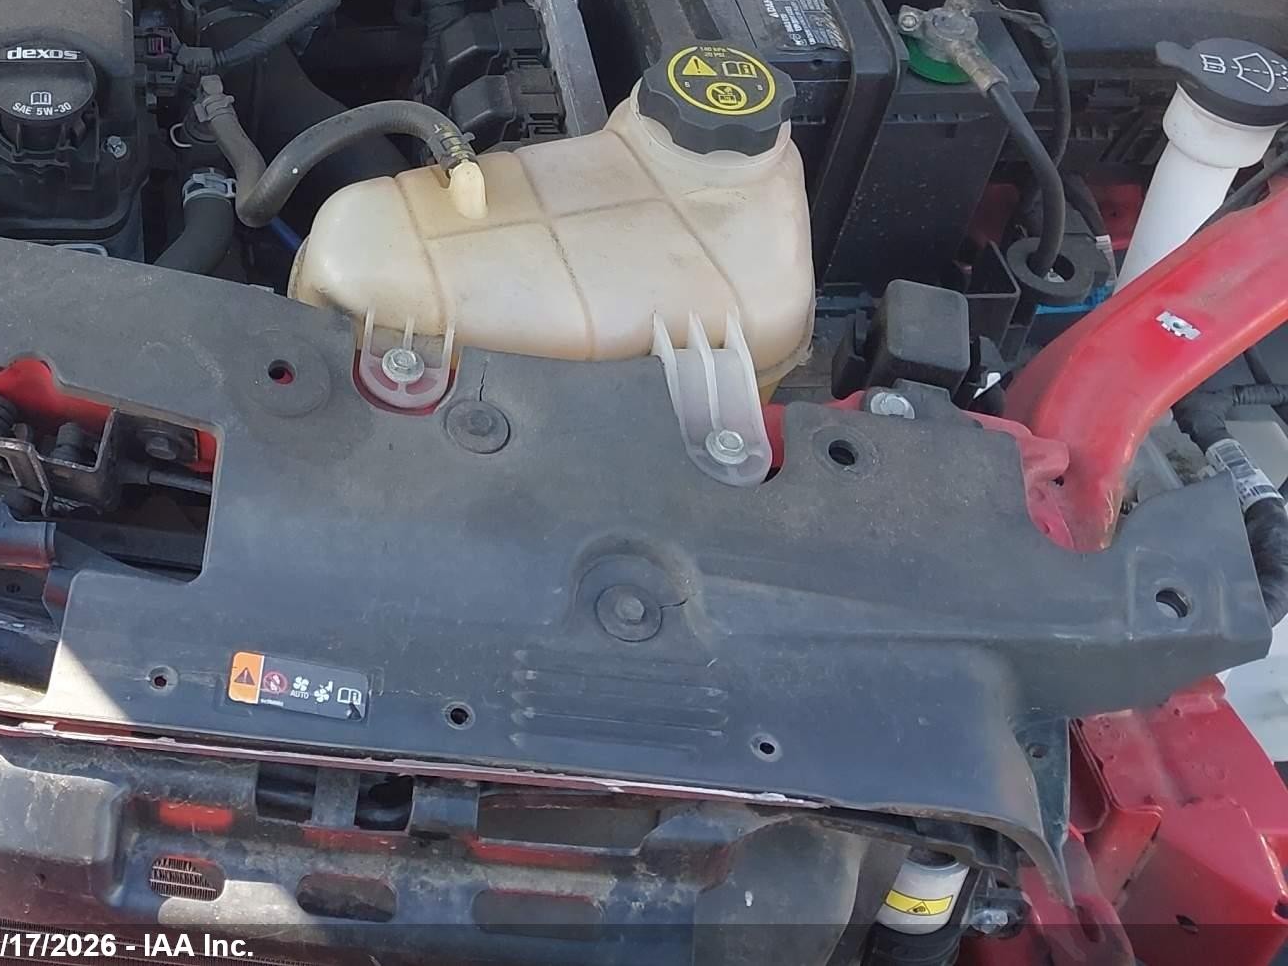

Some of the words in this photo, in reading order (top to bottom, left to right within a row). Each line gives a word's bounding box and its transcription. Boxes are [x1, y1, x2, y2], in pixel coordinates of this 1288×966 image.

[7, 46, 81, 60] dexos
[12, 102, 33, 115] SAE
[36, 101, 72, 116] 5W-30
[289, 689, 310, 700] AUTO
